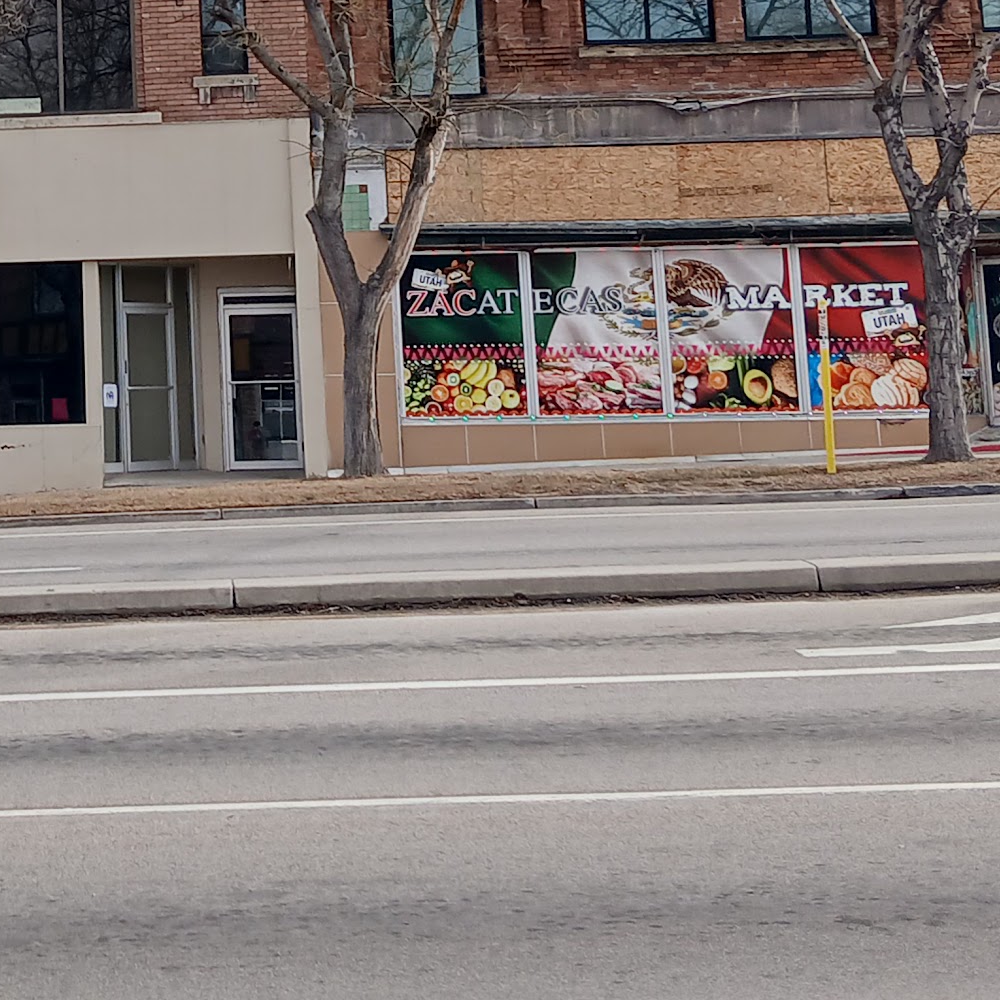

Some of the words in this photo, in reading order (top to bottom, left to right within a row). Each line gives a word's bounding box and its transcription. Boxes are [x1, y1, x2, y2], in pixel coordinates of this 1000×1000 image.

[419, 274, 442, 287] UTAH
[406, 285, 623, 317] ZACATECAS
[724, 283, 909, 310] MARKET
[873, 312, 906, 329] UTAH
